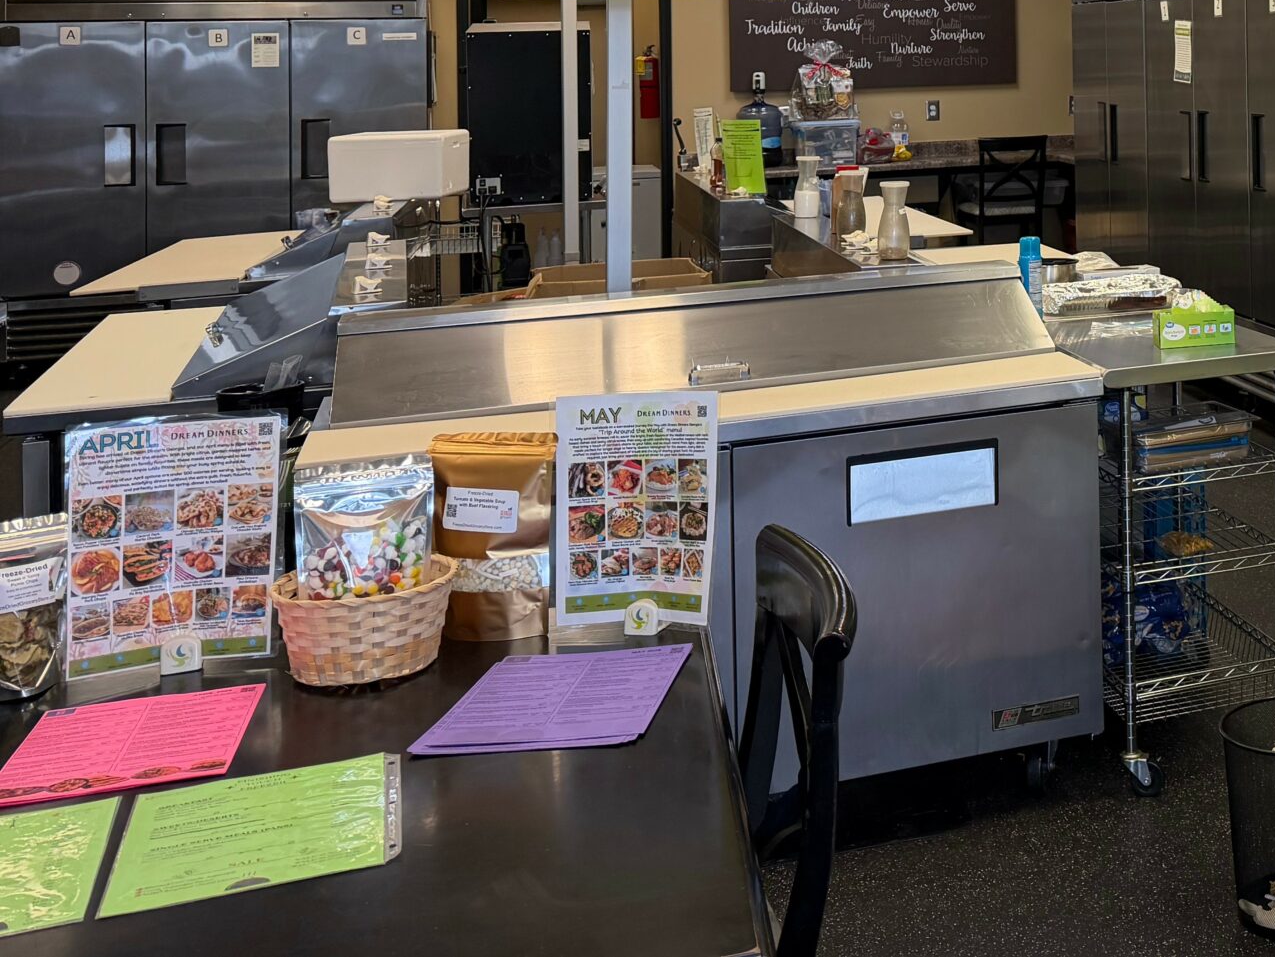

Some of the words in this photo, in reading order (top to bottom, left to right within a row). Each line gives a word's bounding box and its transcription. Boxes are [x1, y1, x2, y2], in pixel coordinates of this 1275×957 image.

[792, 1, 840, 15] Children
[883, 3, 939, 23] Empower
[745, 19, 805, 35] Tradition
[822, 17, 862, 35] Family
[66, 30, 76, 40] A
[215, 34, 223, 43] B
[352, 30, 361, 40] C
[861, 33, 912, 45] Humility
[930, 28, 985, 43] Strengthen
[891, 42, 933, 55] Nurture
[846, 57, 873, 70] Faith
[912, 55, 989, 68] Stewardship
[580, 407, 622, 425] MAY
[662, 408, 691, 417] DINNERS
[171, 431, 205, 441] DREAM
[207, 428, 248, 438] DINNERS
[79, 430, 152, 455] APRIL
[0, 563, 48, 579] reeze-Dried
